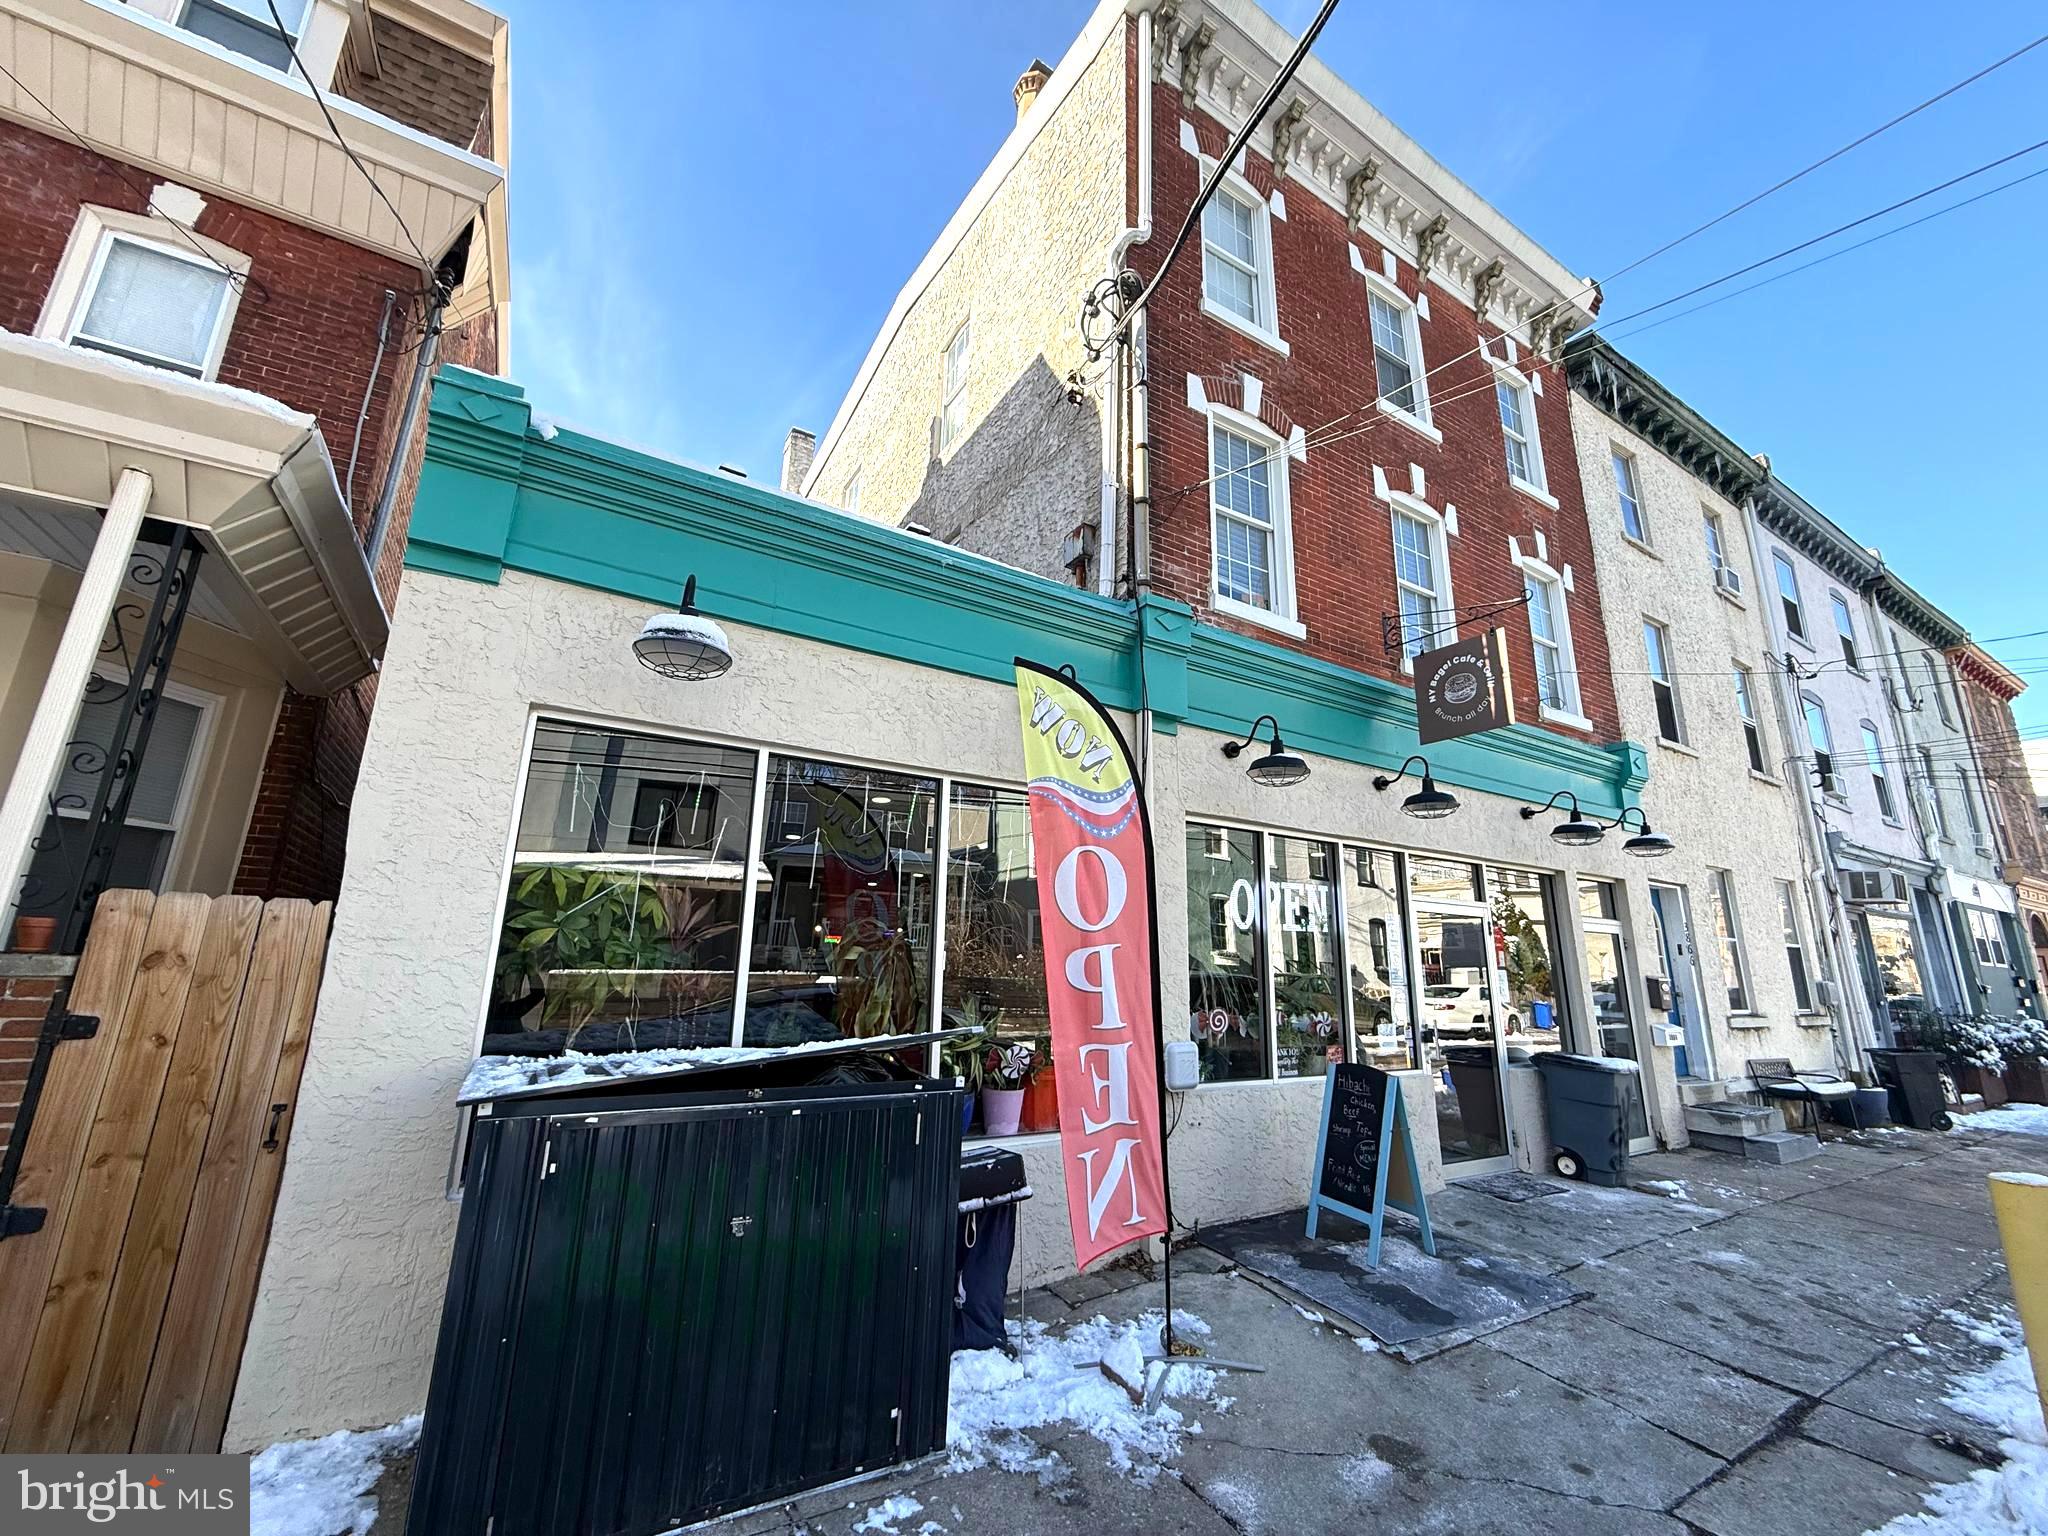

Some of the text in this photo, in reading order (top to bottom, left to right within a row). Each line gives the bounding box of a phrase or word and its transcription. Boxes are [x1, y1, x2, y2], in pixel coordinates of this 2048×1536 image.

[1453, 654, 1476, 664] Cafe
[1476, 659, 1484, 668] &
[1430, 660, 1452, 687] Bagel
[1428, 689, 1436, 703] NY
[1435, 695, 1491, 722] Brunch all day
